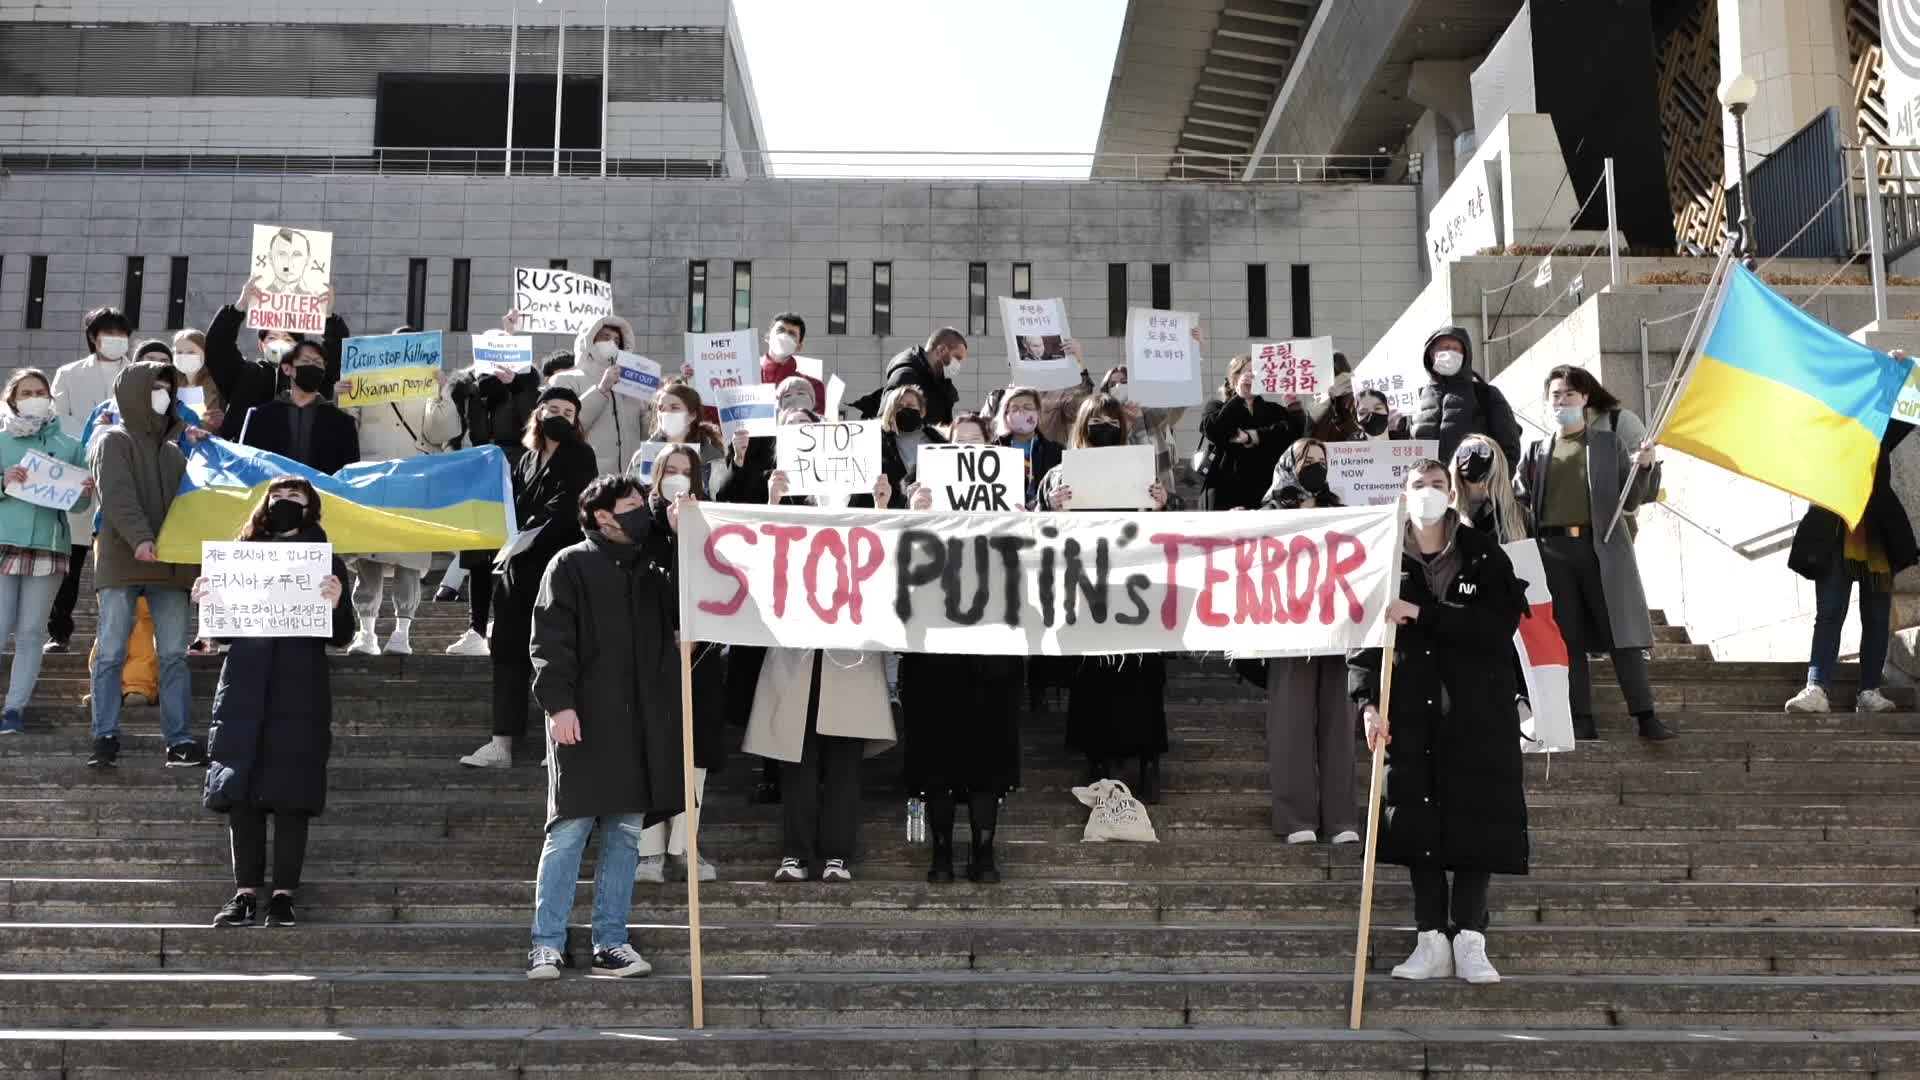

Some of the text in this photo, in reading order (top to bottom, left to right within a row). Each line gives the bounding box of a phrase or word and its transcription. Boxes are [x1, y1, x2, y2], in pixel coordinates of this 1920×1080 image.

[516, 268, 611, 300] RUSSIANS
[258, 292, 321, 313] PUTLER
[249, 309, 283, 329] BURN
[299, 312, 324, 331] HELL
[518, 313, 557, 331] This
[711, 339, 731, 348] НЕТ
[796, 423, 864, 453] STOP
[28, 456, 64, 480] NO
[957, 450, 1001, 484] NO
[1341, 457, 1374, 465] Ukraine
[793, 456, 869, 488] PUTIN
[1341, 470, 1365, 478] NOW
[21, 483, 78, 504] WAR
[946, 483, 1011, 511] WAR
[211, 573, 259, 590] 러시아
[277, 573, 313, 591] 푸틴
[697, 524, 887, 627] STOP
[1150, 531, 1368, 630] TERROR
[203, 602, 225, 616] 저는
[230, 603, 286, 617] 우크라이나
[267, 616, 327, 629] 반대합니다
